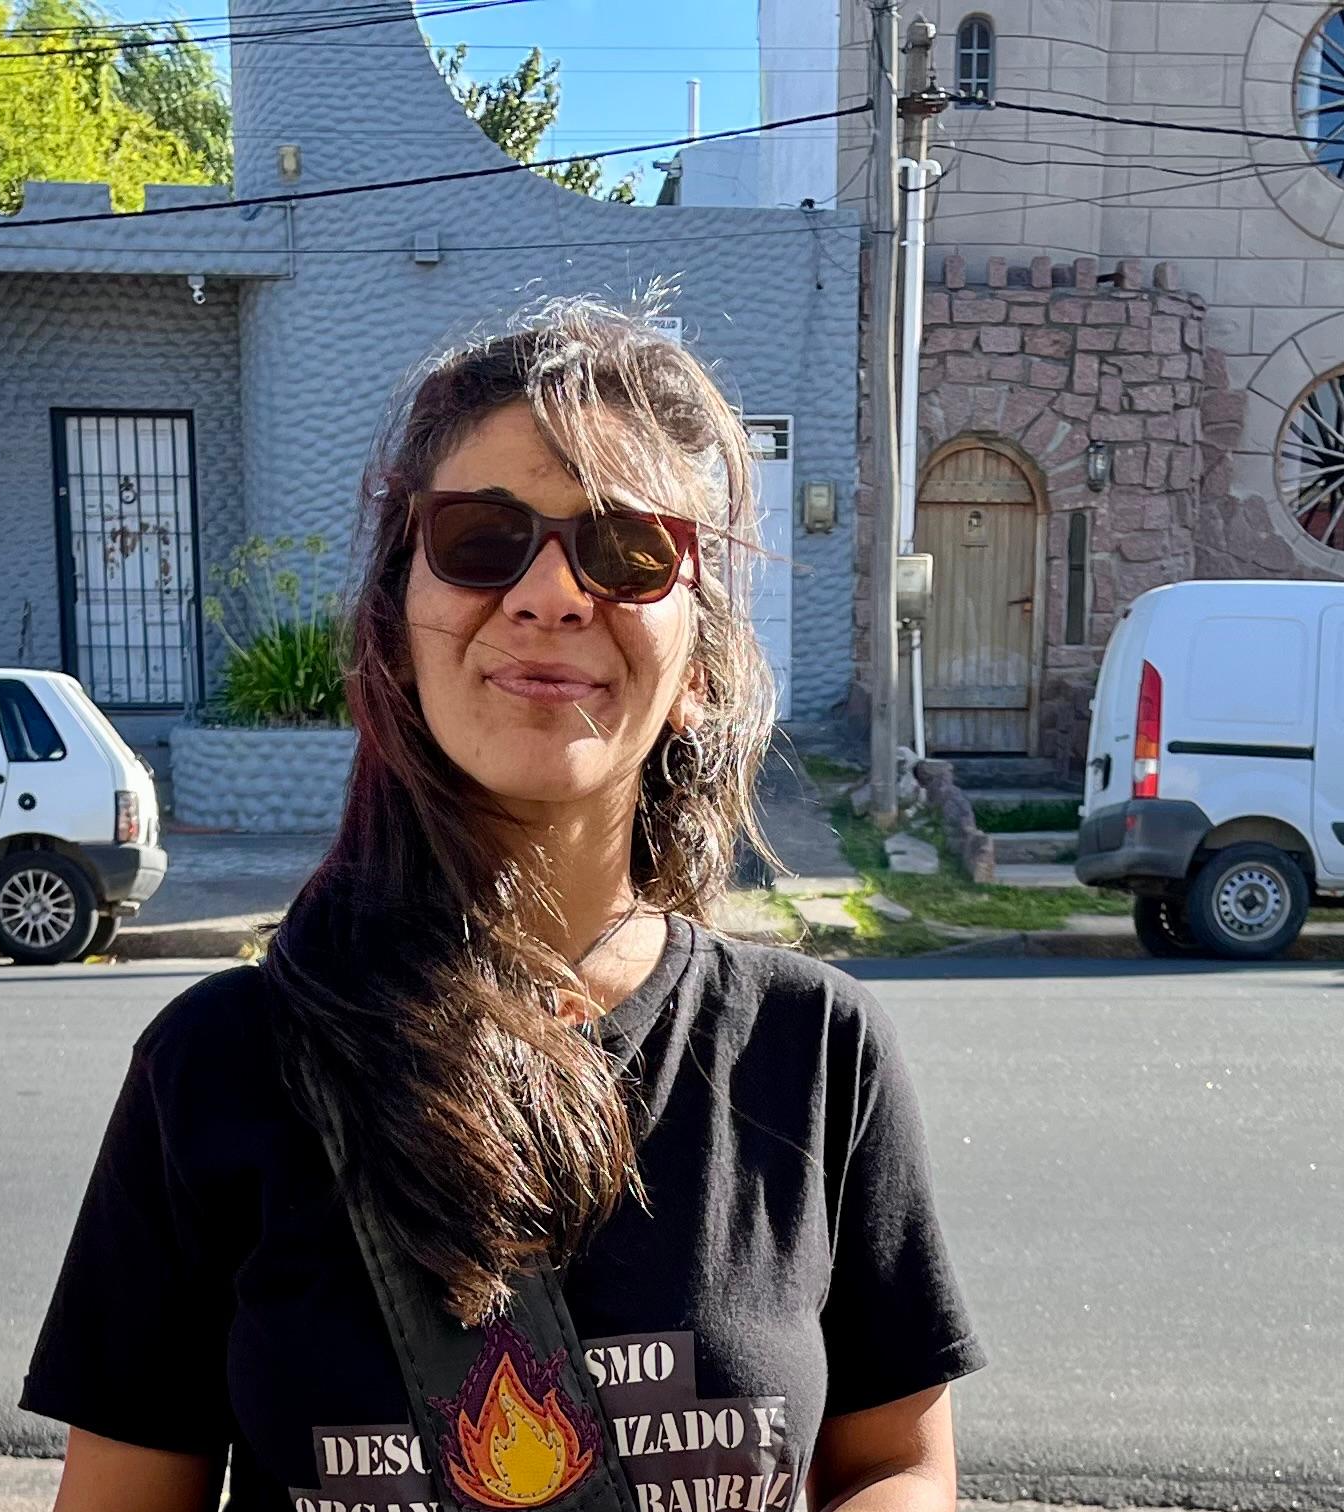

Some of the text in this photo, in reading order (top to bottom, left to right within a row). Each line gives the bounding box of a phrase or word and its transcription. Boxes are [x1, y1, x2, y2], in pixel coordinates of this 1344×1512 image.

[584, 1341, 674, 1388] SMO
[321, 1407, 778, 1476] DESC IZADO Y
